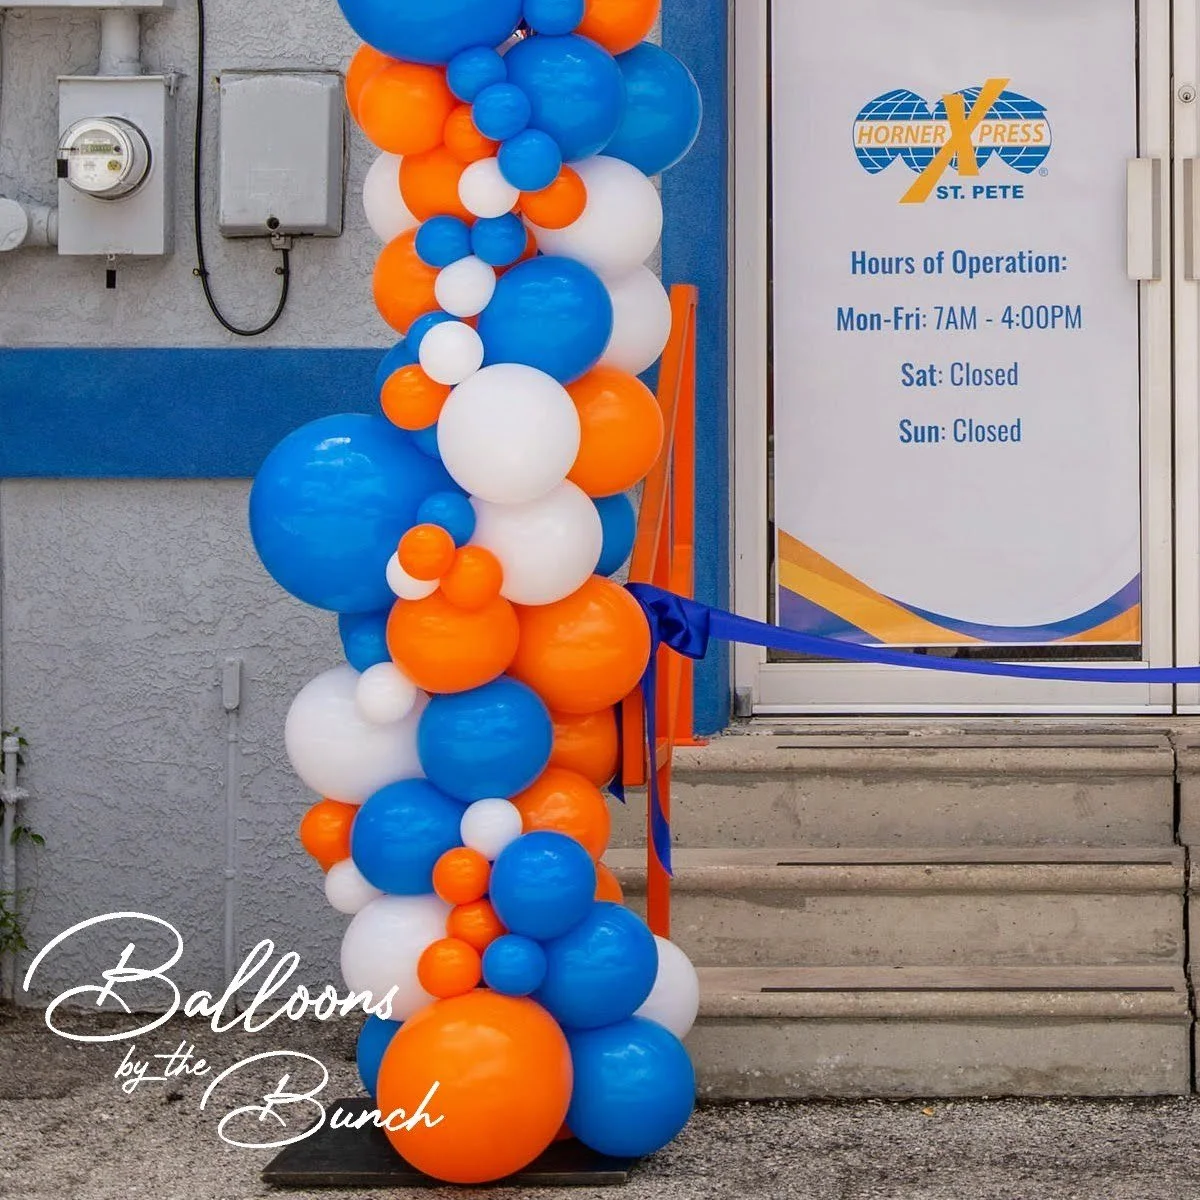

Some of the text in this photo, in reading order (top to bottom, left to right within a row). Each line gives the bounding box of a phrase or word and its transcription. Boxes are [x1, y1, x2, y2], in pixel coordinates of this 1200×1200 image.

[936, 185, 1024, 199] ST. PETE
[851, 250, 1067, 279] Hours of Operation:
[836, 306, 927, 331] Mon-Fri:
[933, 306, 977, 330] 7AM
[1000, 305, 1082, 329] 4:00PM
[901, 362, 1019, 387] Sat: Closed
[899, 418, 1022, 443] Sun: Closed
